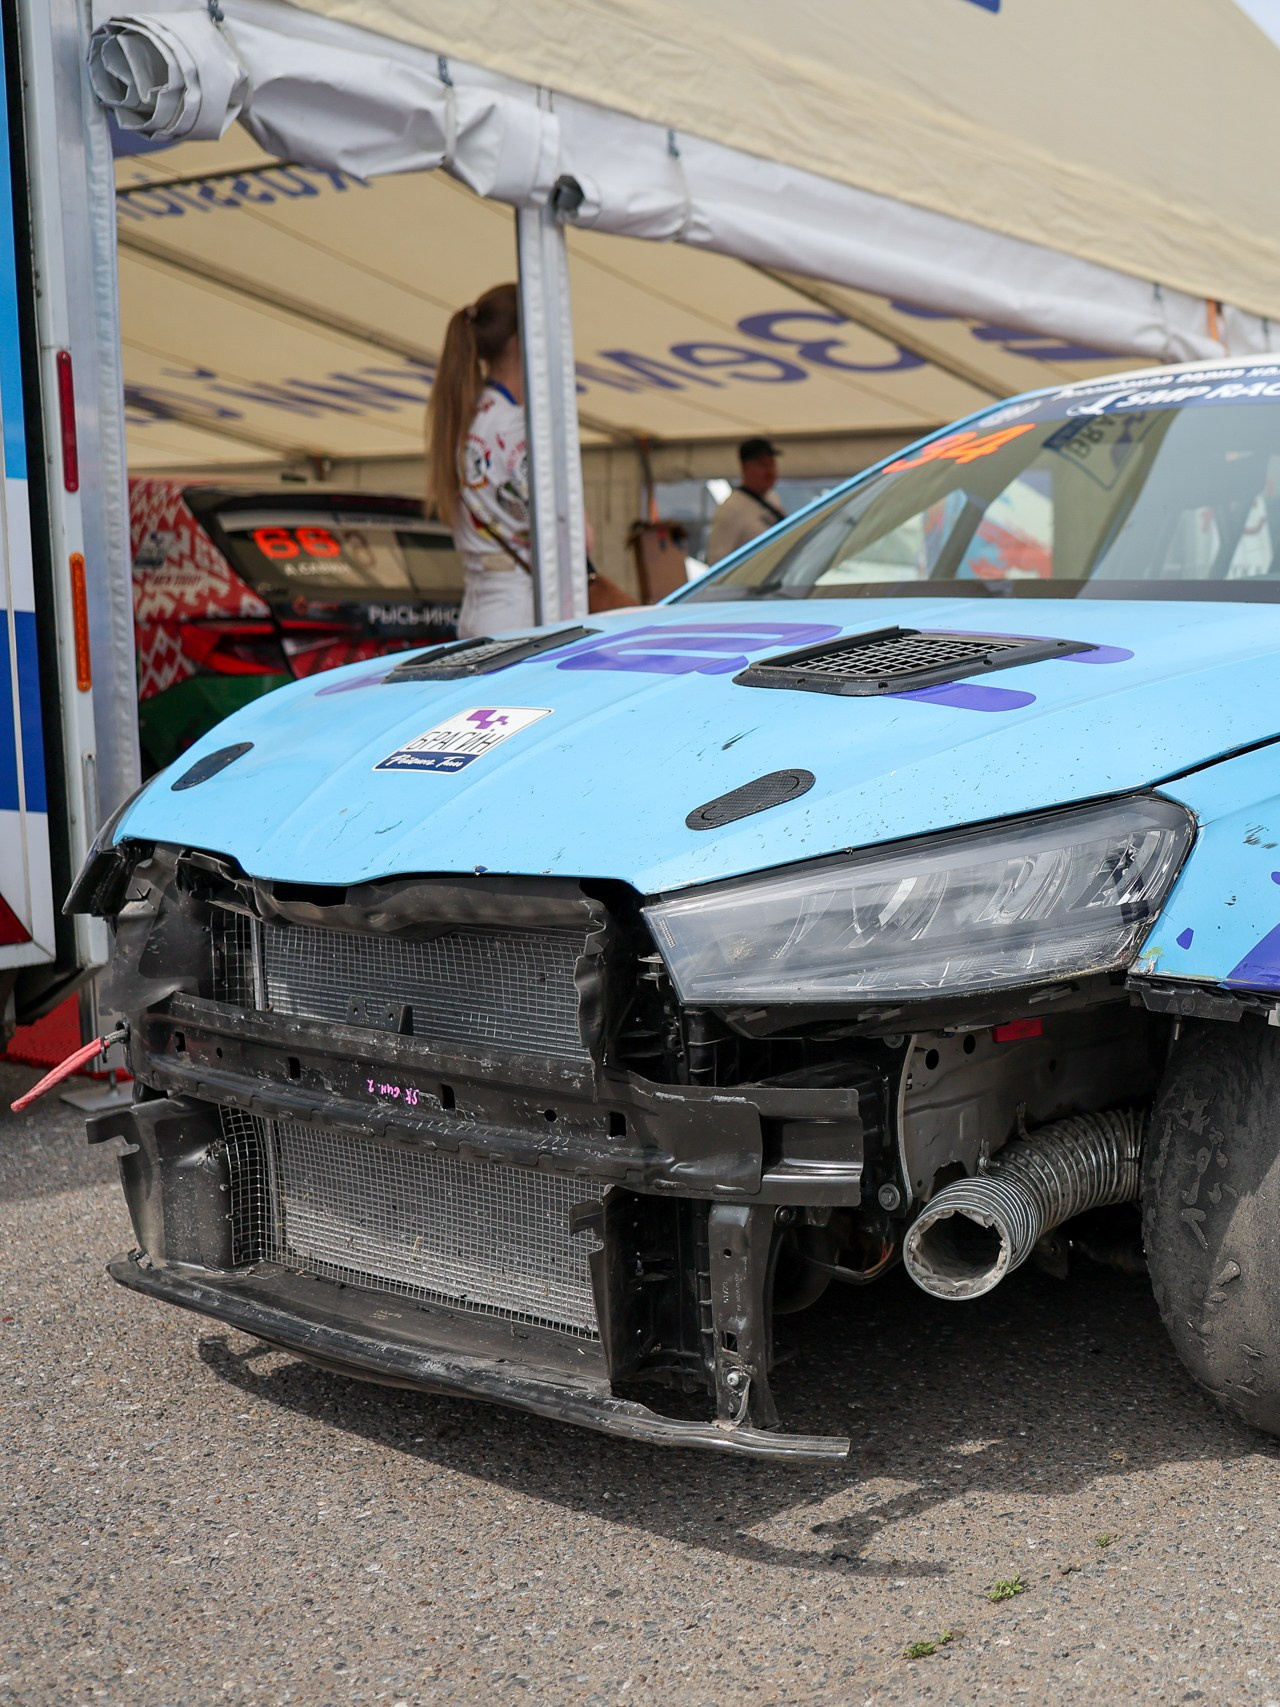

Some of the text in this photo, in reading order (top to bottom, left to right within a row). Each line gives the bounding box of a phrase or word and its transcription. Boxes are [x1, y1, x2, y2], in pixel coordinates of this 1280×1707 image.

[1115, 385, 1211, 408] SMP
[253, 526, 341, 559] 66
[406, 731, 505, 754] БРАГИН
